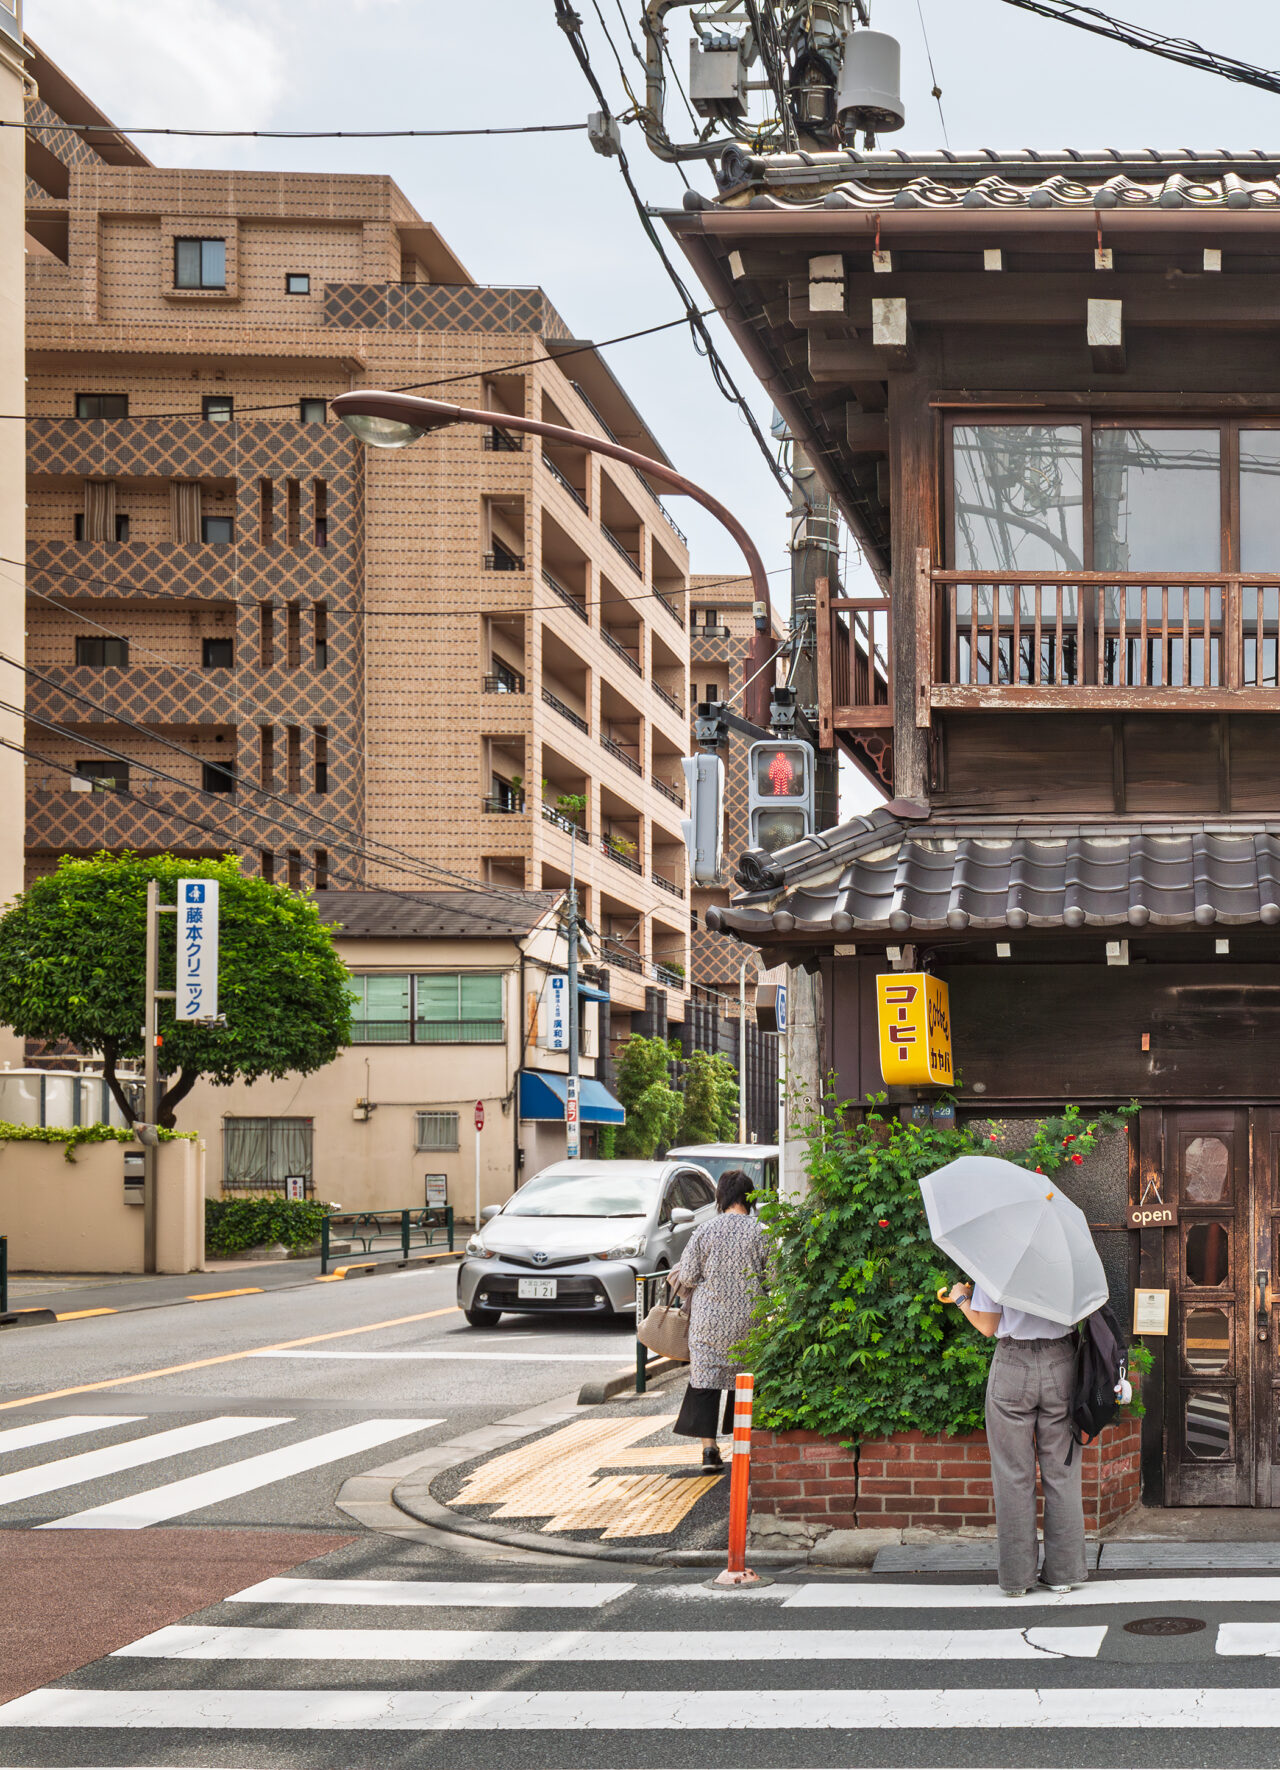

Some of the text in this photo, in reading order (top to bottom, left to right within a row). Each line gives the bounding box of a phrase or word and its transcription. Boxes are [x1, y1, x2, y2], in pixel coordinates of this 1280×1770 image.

[185, 907, 203, 1016] 藤本クリニック
[885, 985, 918, 1061] コーヒー
[1131, 1209, 1173, 1226] open
